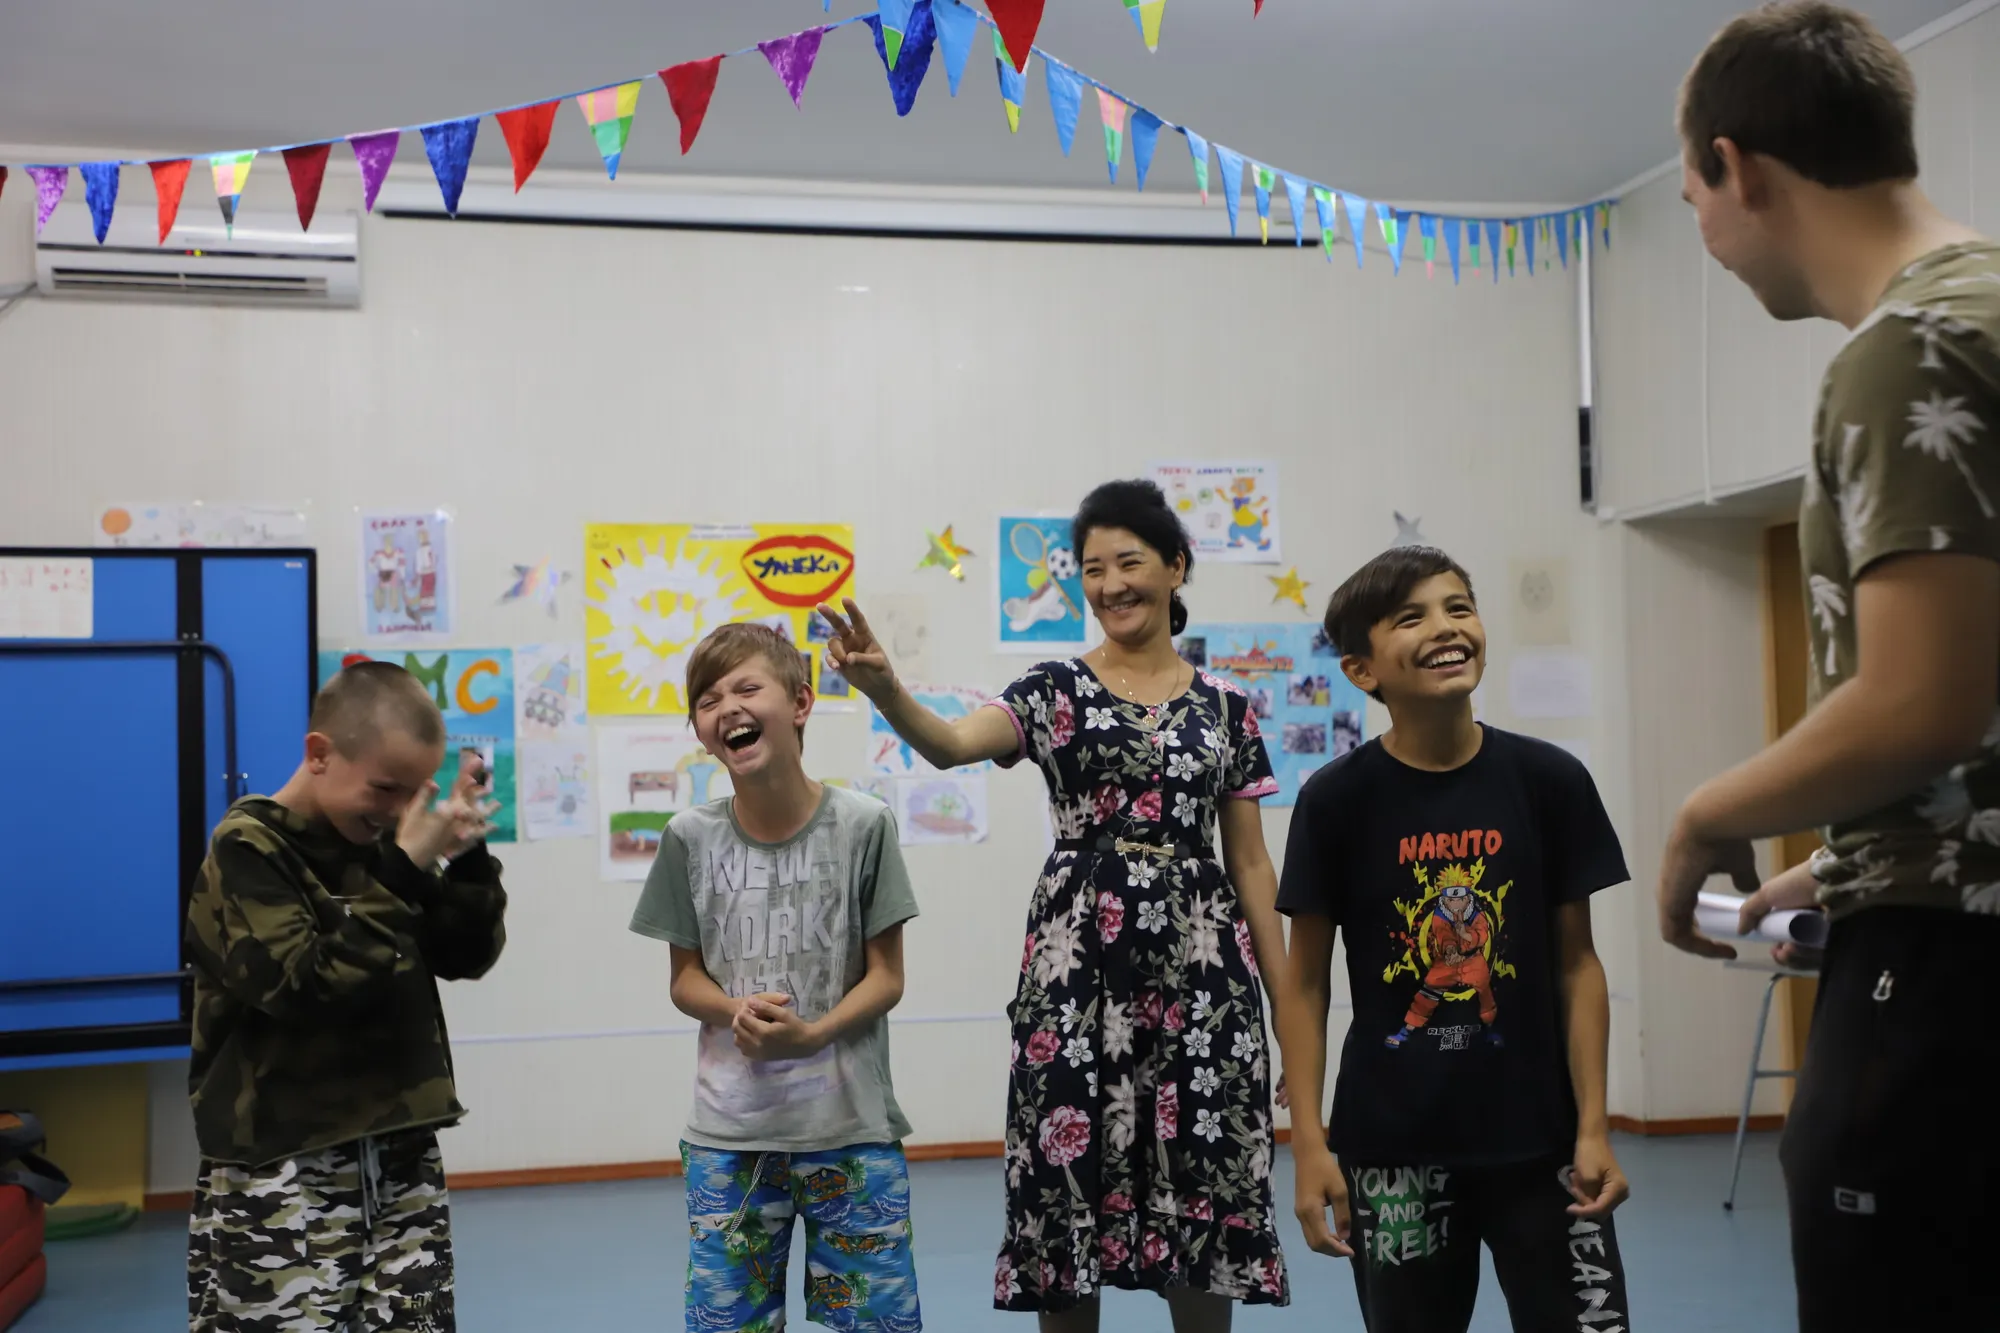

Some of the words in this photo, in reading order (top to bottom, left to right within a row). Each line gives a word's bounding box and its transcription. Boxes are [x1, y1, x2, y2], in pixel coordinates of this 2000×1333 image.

[1399, 829, 1502, 864] NARUTO
[710, 842, 814, 895] NEW
[712, 887, 838, 963] YORK
[1350, 1165, 1450, 1199] YOUNG
[1379, 1201, 1425, 1227] AND
[1364, 1216, 1448, 1266] FREE!
